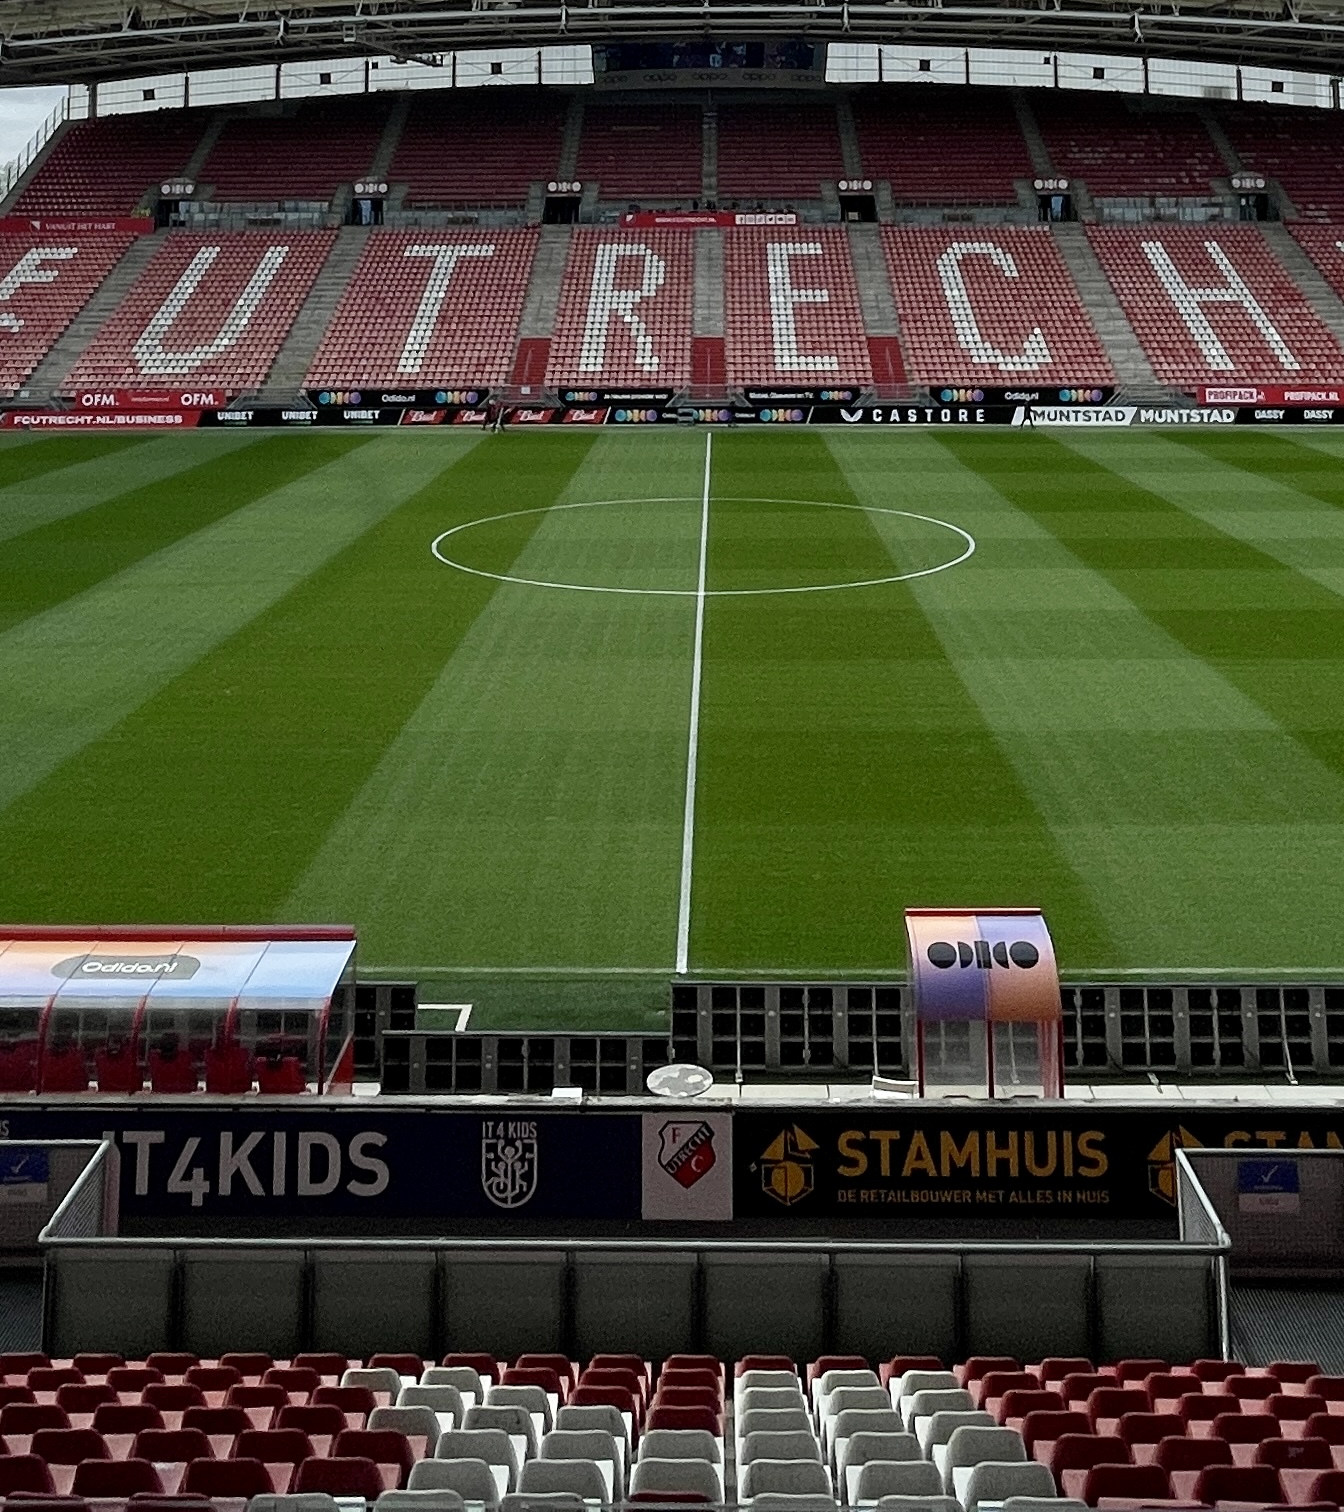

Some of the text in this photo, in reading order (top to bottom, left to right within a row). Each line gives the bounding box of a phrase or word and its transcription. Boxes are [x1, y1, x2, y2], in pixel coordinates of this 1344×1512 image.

[81, 393, 119, 407] OFM.
[180, 393, 219, 406] OFM.
[13, 414, 183, 425] FCUTRECHT.NL/BUSINESS
[872, 408, 986, 423] CASTORE
[1032, 409, 1127, 422] MUNTSTAD
[1140, 409, 1236, 423] MUNTSTAD
[81, 961, 178, 974] Odido.nl
[482, 1121, 538, 1139] IT 4 KIDS
[837, 1130, 1109, 1178] STAMHUIS
[102, 1130, 390, 1207] T4KIDS
[837, 1189, 1110, 1204] DE RETAILBOUWER MET ALLES IN HUIS
